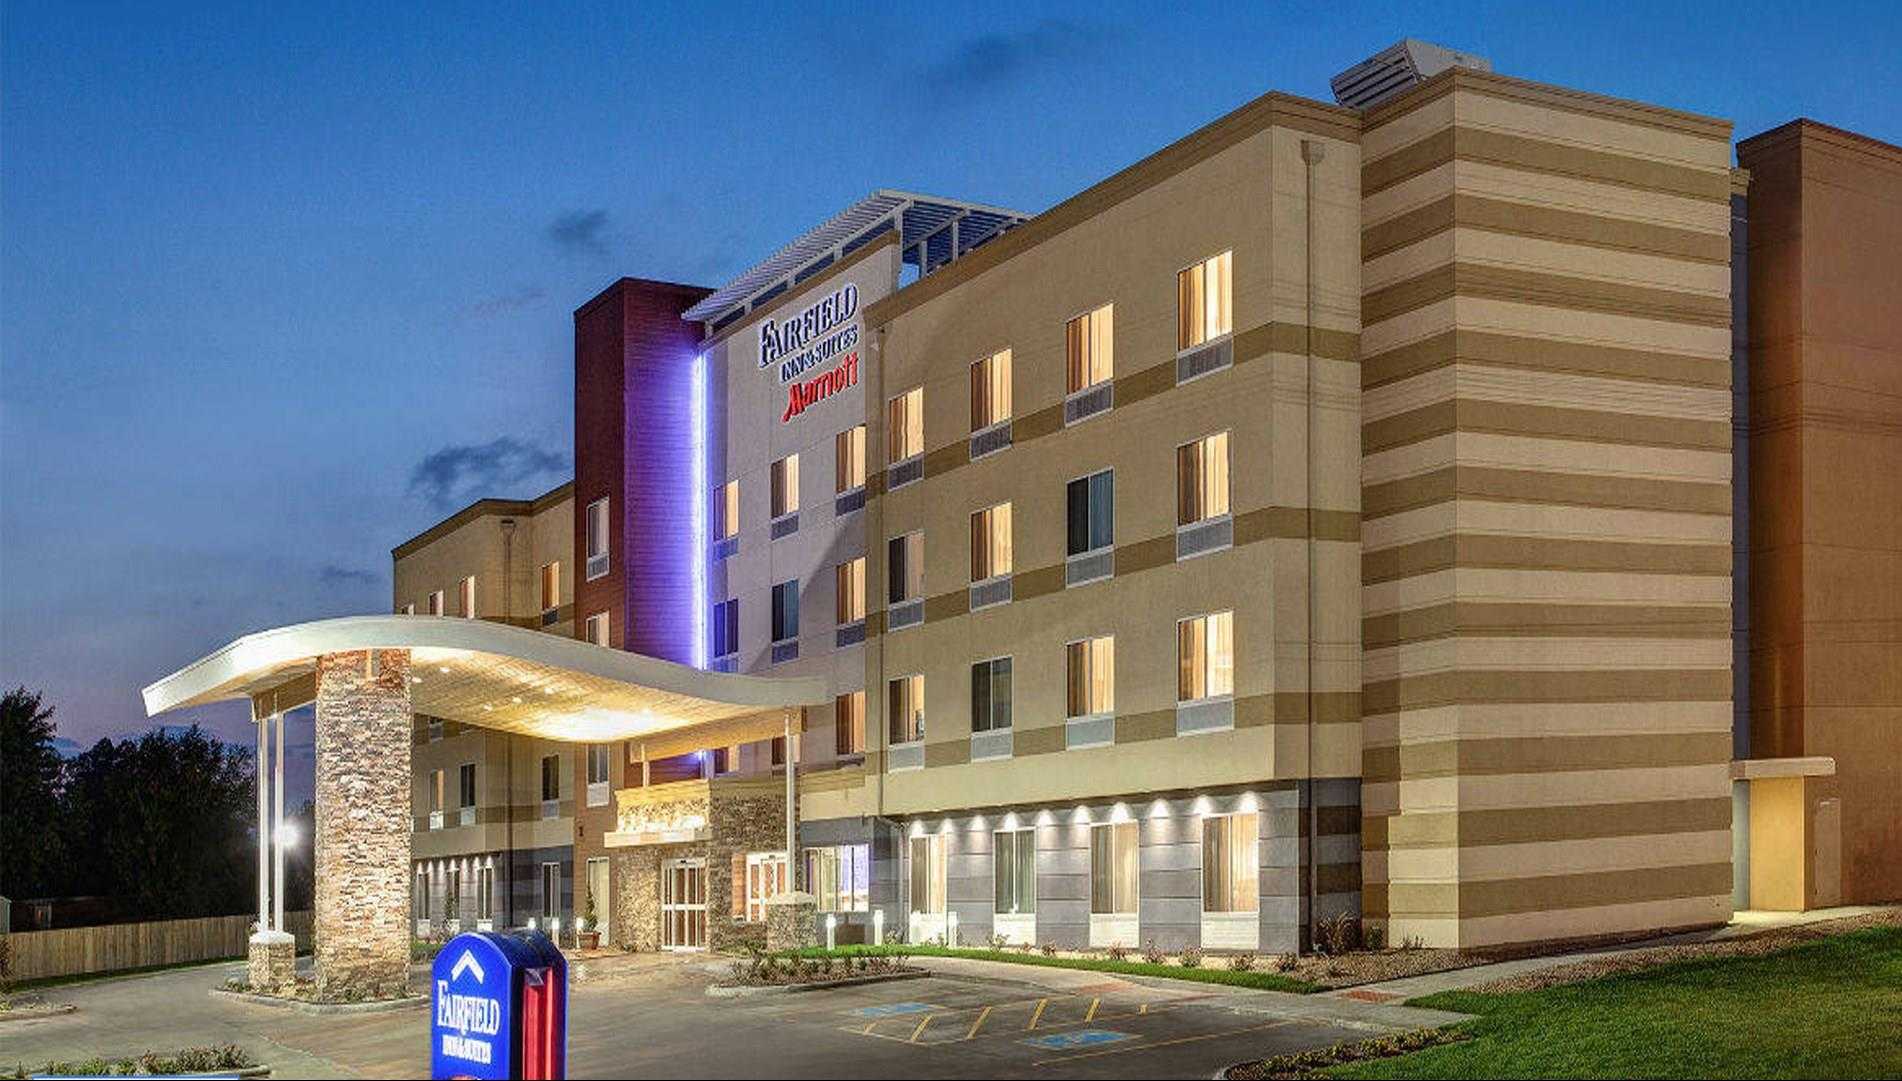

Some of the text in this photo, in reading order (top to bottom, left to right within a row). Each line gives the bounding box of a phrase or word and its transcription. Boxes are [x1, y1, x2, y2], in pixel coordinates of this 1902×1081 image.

[760, 284, 858, 369] FAIRFIELD
[782, 352, 858, 422] Marriott
[437, 980, 499, 1035] FAIRFIELD
